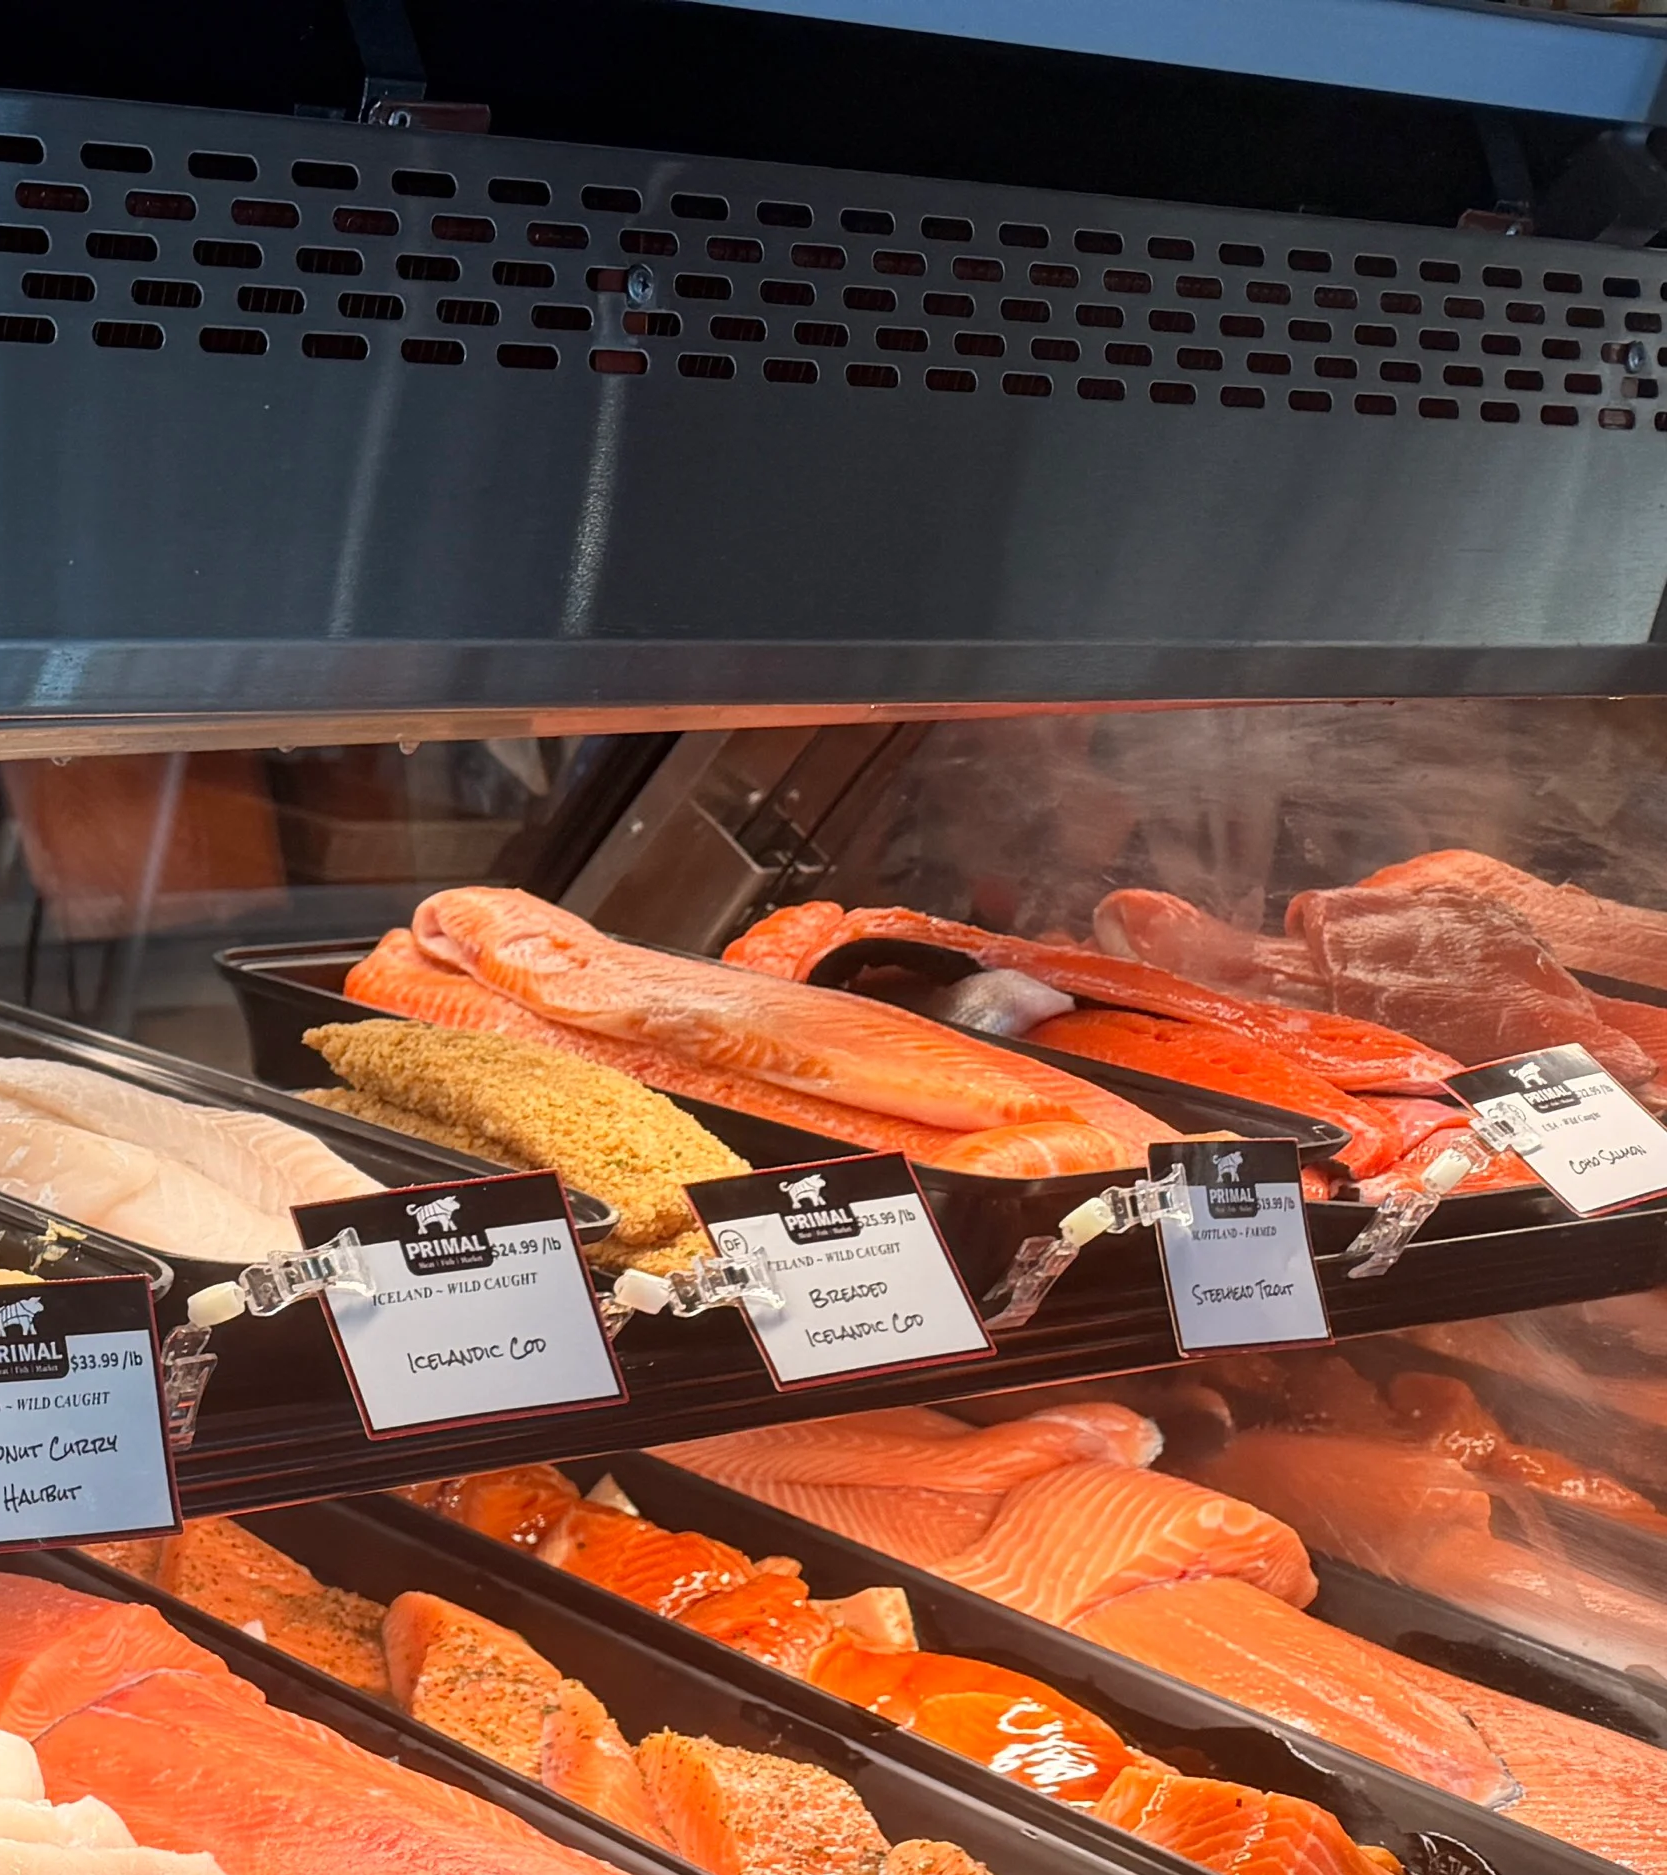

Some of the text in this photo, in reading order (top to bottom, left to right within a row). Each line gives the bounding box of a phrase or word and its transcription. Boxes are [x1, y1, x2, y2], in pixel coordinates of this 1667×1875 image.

[1523, 1085, 1572, 1105] PRIMAL
[1209, 1188, 1255, 1203] PRIMAL
[784, 1208, 853, 1232] PRIMAL
[899, 1209, 915, 1225] /lb
[406, 1235, 486, 1261] PRIMAL
[491, 1237, 561, 1259] $24.99 /lb
[724, 1238, 741, 1251] DF
[825, 1251, 854, 1263] WILD
[856, 1242, 901, 1258] CAUGHT
[372, 1272, 538, 1306] ICELAND WILD CAUGHT
[809, 1282, 887, 1308] BREADED
[1255, 1279, 1294, 1300] TROUT
[805, 1313, 923, 1347] ICELANDIC COD
[71, 1351, 143, 1372] $33.99 /lb
[407, 1337, 547, 1373] ICELANDIC COD
[17, 1397, 50, 1410] WILD
[55, 1392, 110, 1408] CAUGHT
[49, 1435, 118, 1461] CURRY
[3, 1485, 82, 1513] HALIBUT
